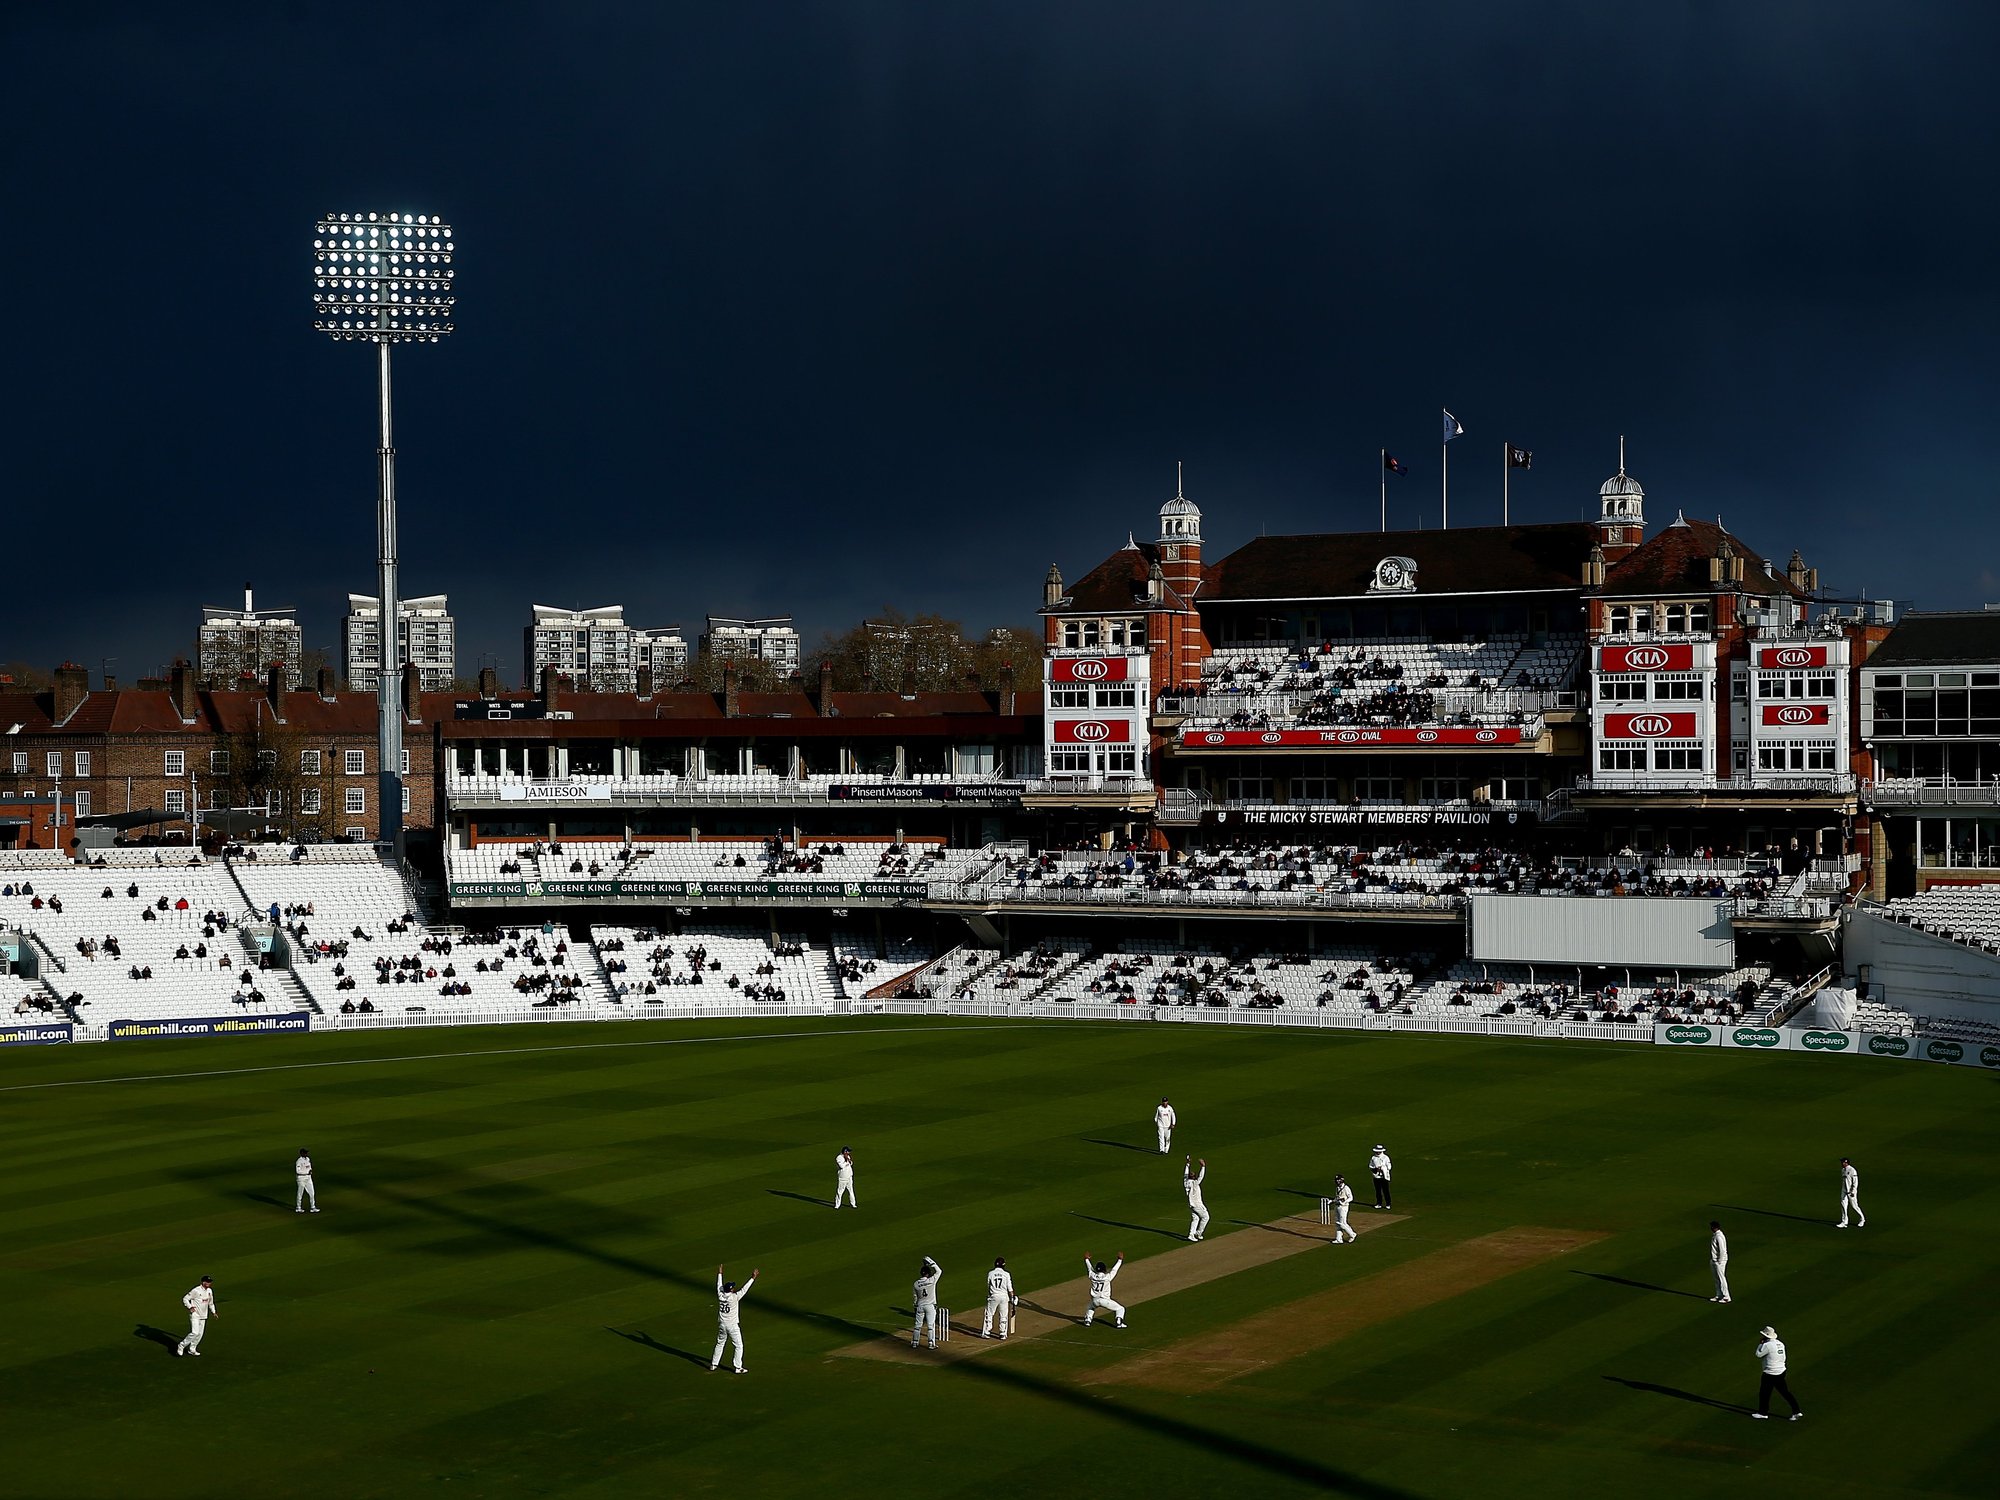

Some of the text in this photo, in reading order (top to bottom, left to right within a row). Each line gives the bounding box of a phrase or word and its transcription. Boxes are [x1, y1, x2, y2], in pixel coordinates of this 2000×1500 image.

[1632, 651, 1662, 665] KIA
[1782, 652, 1806, 663] KIA
[1078, 664, 1102, 676] KIA
[1784, 710, 1807, 720] KIA
[1079, 725, 1104, 737] KIA
[1635, 719, 1665, 732] KIA
[1208, 734, 1222, 742] KIA
[1319, 732, 1336, 741] THE
[1361, 731, 1382, 741] OVAL
[1420, 732, 1434, 740] KIA
[523, 786, 588, 799] JAMIESON
[851, 787, 923, 797] Pinsent Masons
[955, 787, 1022, 797] Pinsent Masons
[1243, 812, 1267, 823] THE
[1269, 812, 1307, 823] MICKY
[1309, 812, 1364, 824] STEWART
[1434, 812, 1491, 824] PAVILION
[456, 882, 612, 895] GREENE KING IPA GREENE KING
[621, 881, 769, 894] GREENE KING IPA GREENE KING
[777, 882, 926, 895] GREENE KING IPA GREENE KING
[114, 1018, 305, 1037] williamhill.com williamhill.com
[1669, 1029, 1708, 1039] Specsavers
[1736, 1032, 1776, 1042] Specsavers
[1805, 1035, 1845, 1045] Specsavers
[1872, 1039, 1906, 1051] Specsavers
[1930, 1045, 1960, 1057] Specsavers
[993, 1278, 1003, 1289] 17
